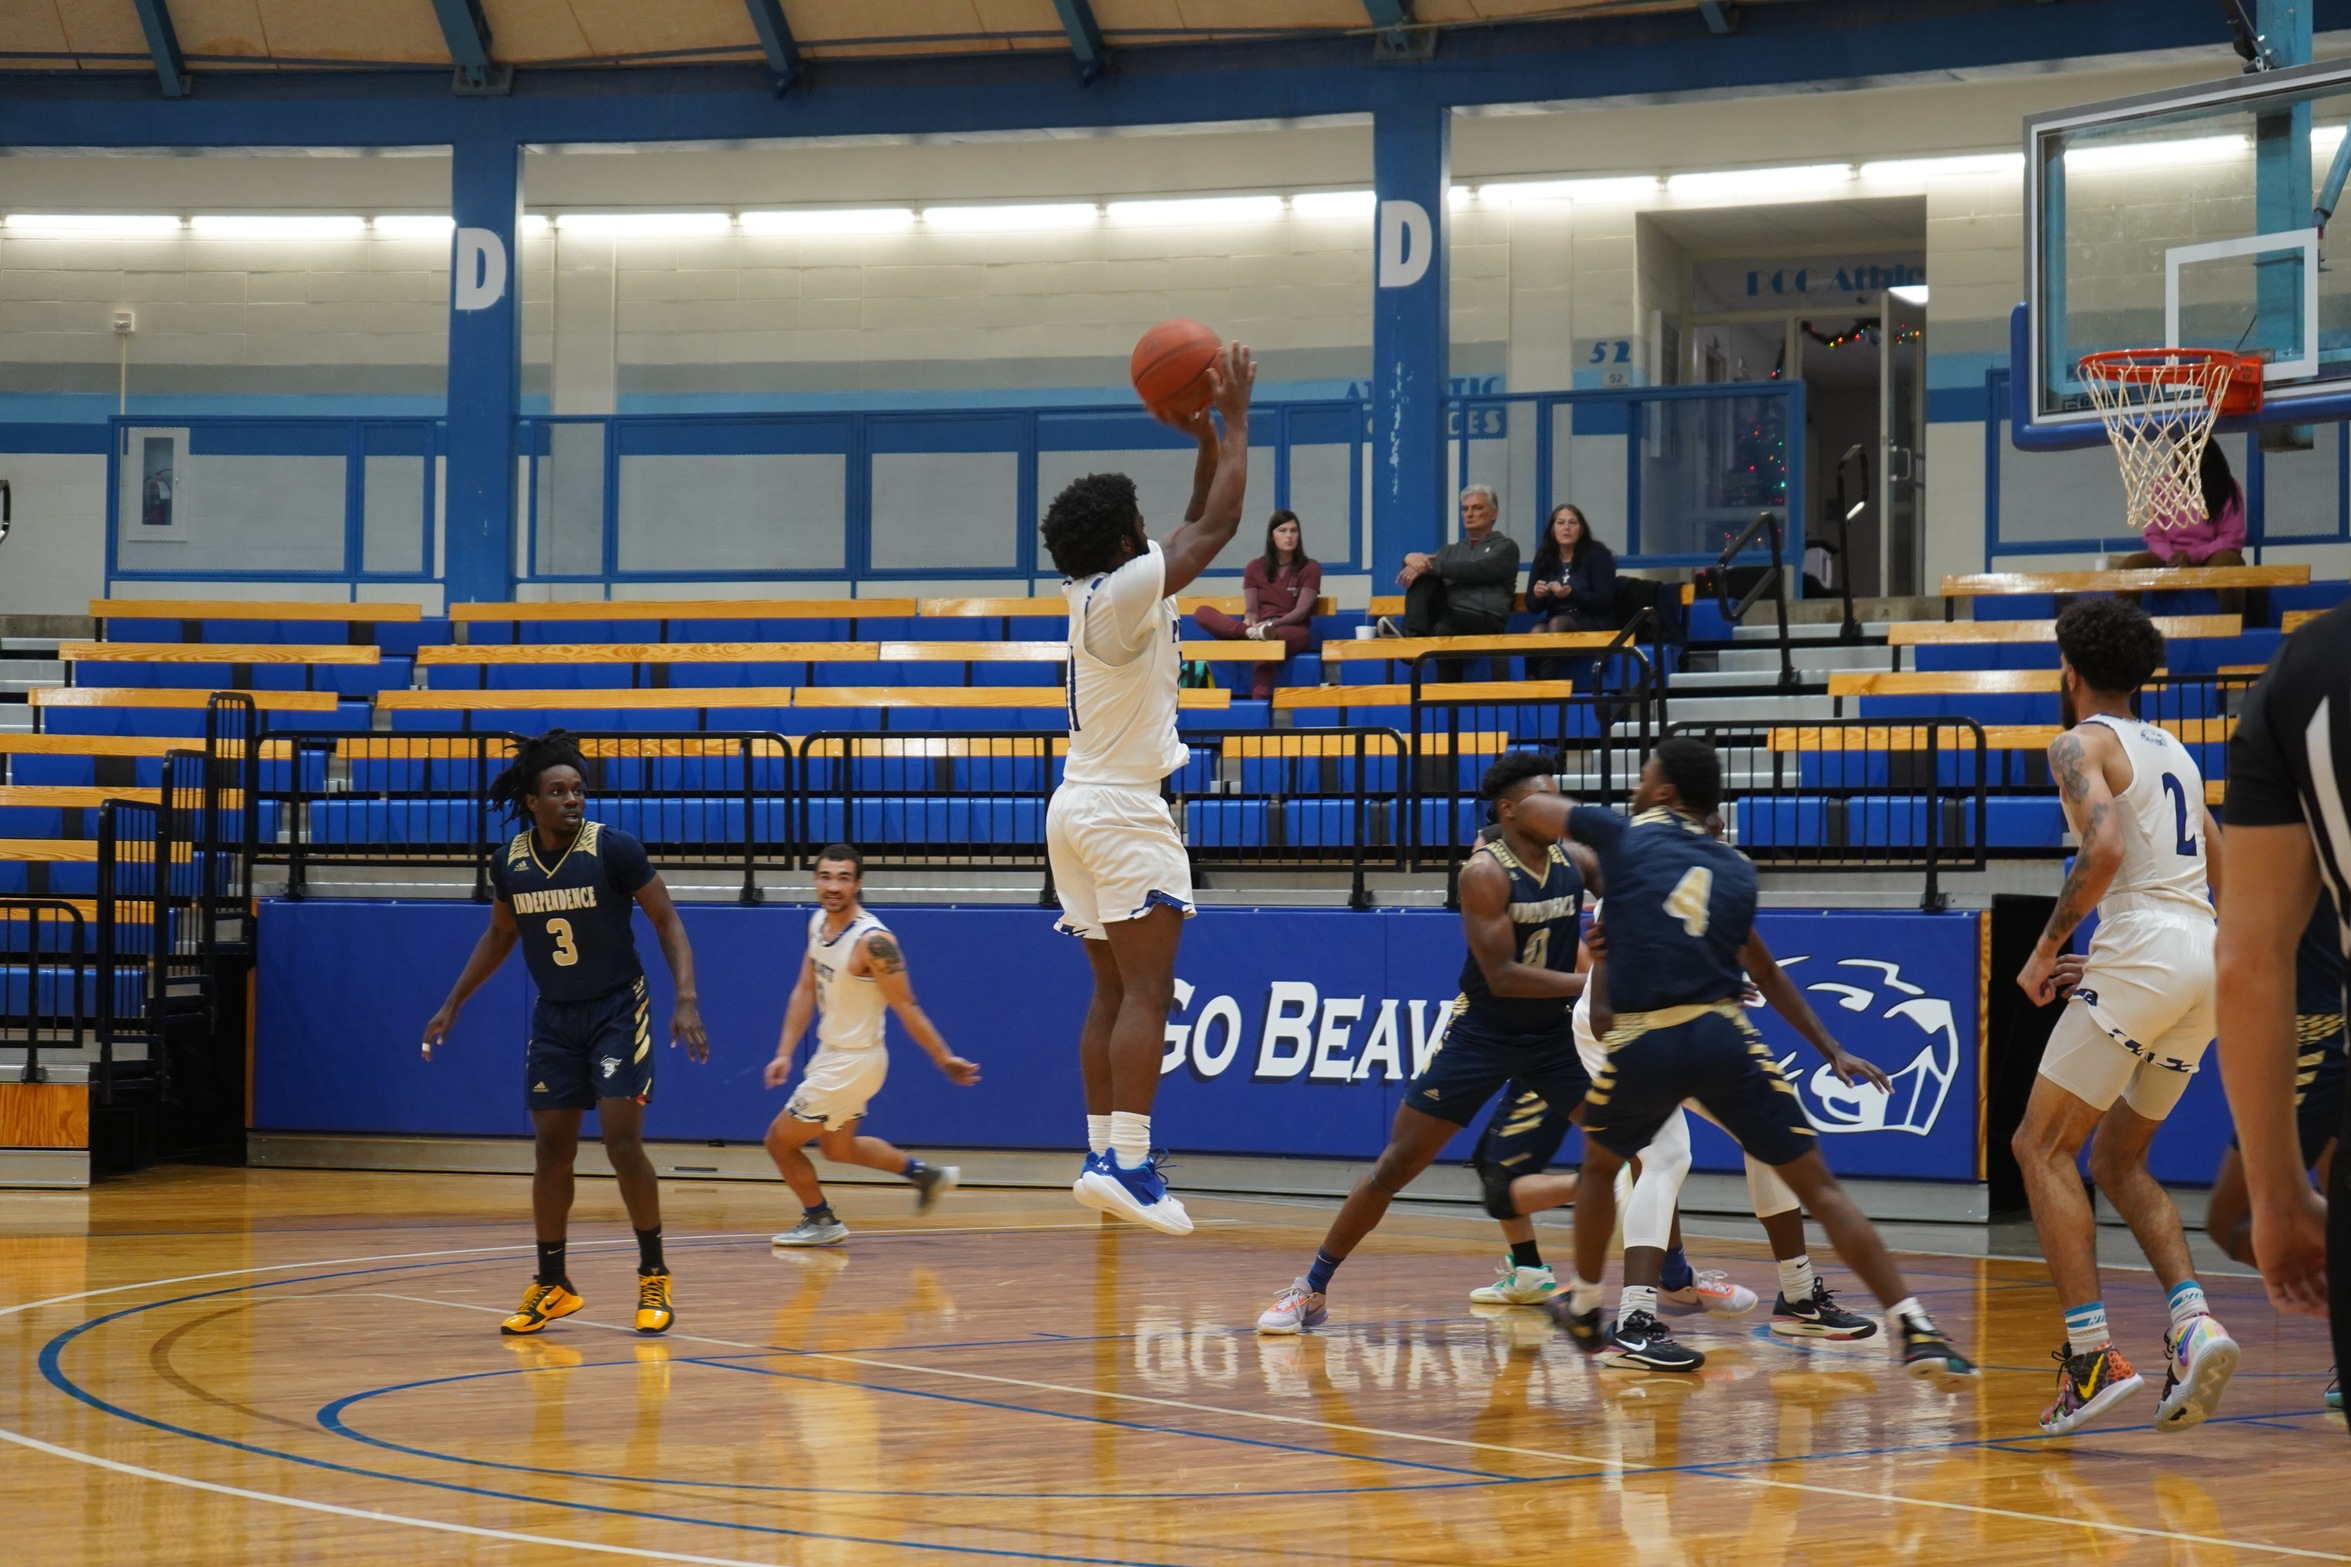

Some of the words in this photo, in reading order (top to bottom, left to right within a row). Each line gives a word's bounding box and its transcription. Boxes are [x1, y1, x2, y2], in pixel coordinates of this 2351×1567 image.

[1379, 199, 1433, 288] D
[455, 227, 507, 311] D
[1746, 267, 1819, 297] PCC
[1589, 341, 1631, 364] 52
[1609, 373, 1623, 384] 52
[2161, 771, 2197, 857] 2
[512, 885, 598, 915] INDEPENDENCE
[1661, 866, 1714, 938] 4
[546, 917, 579, 967] 3
